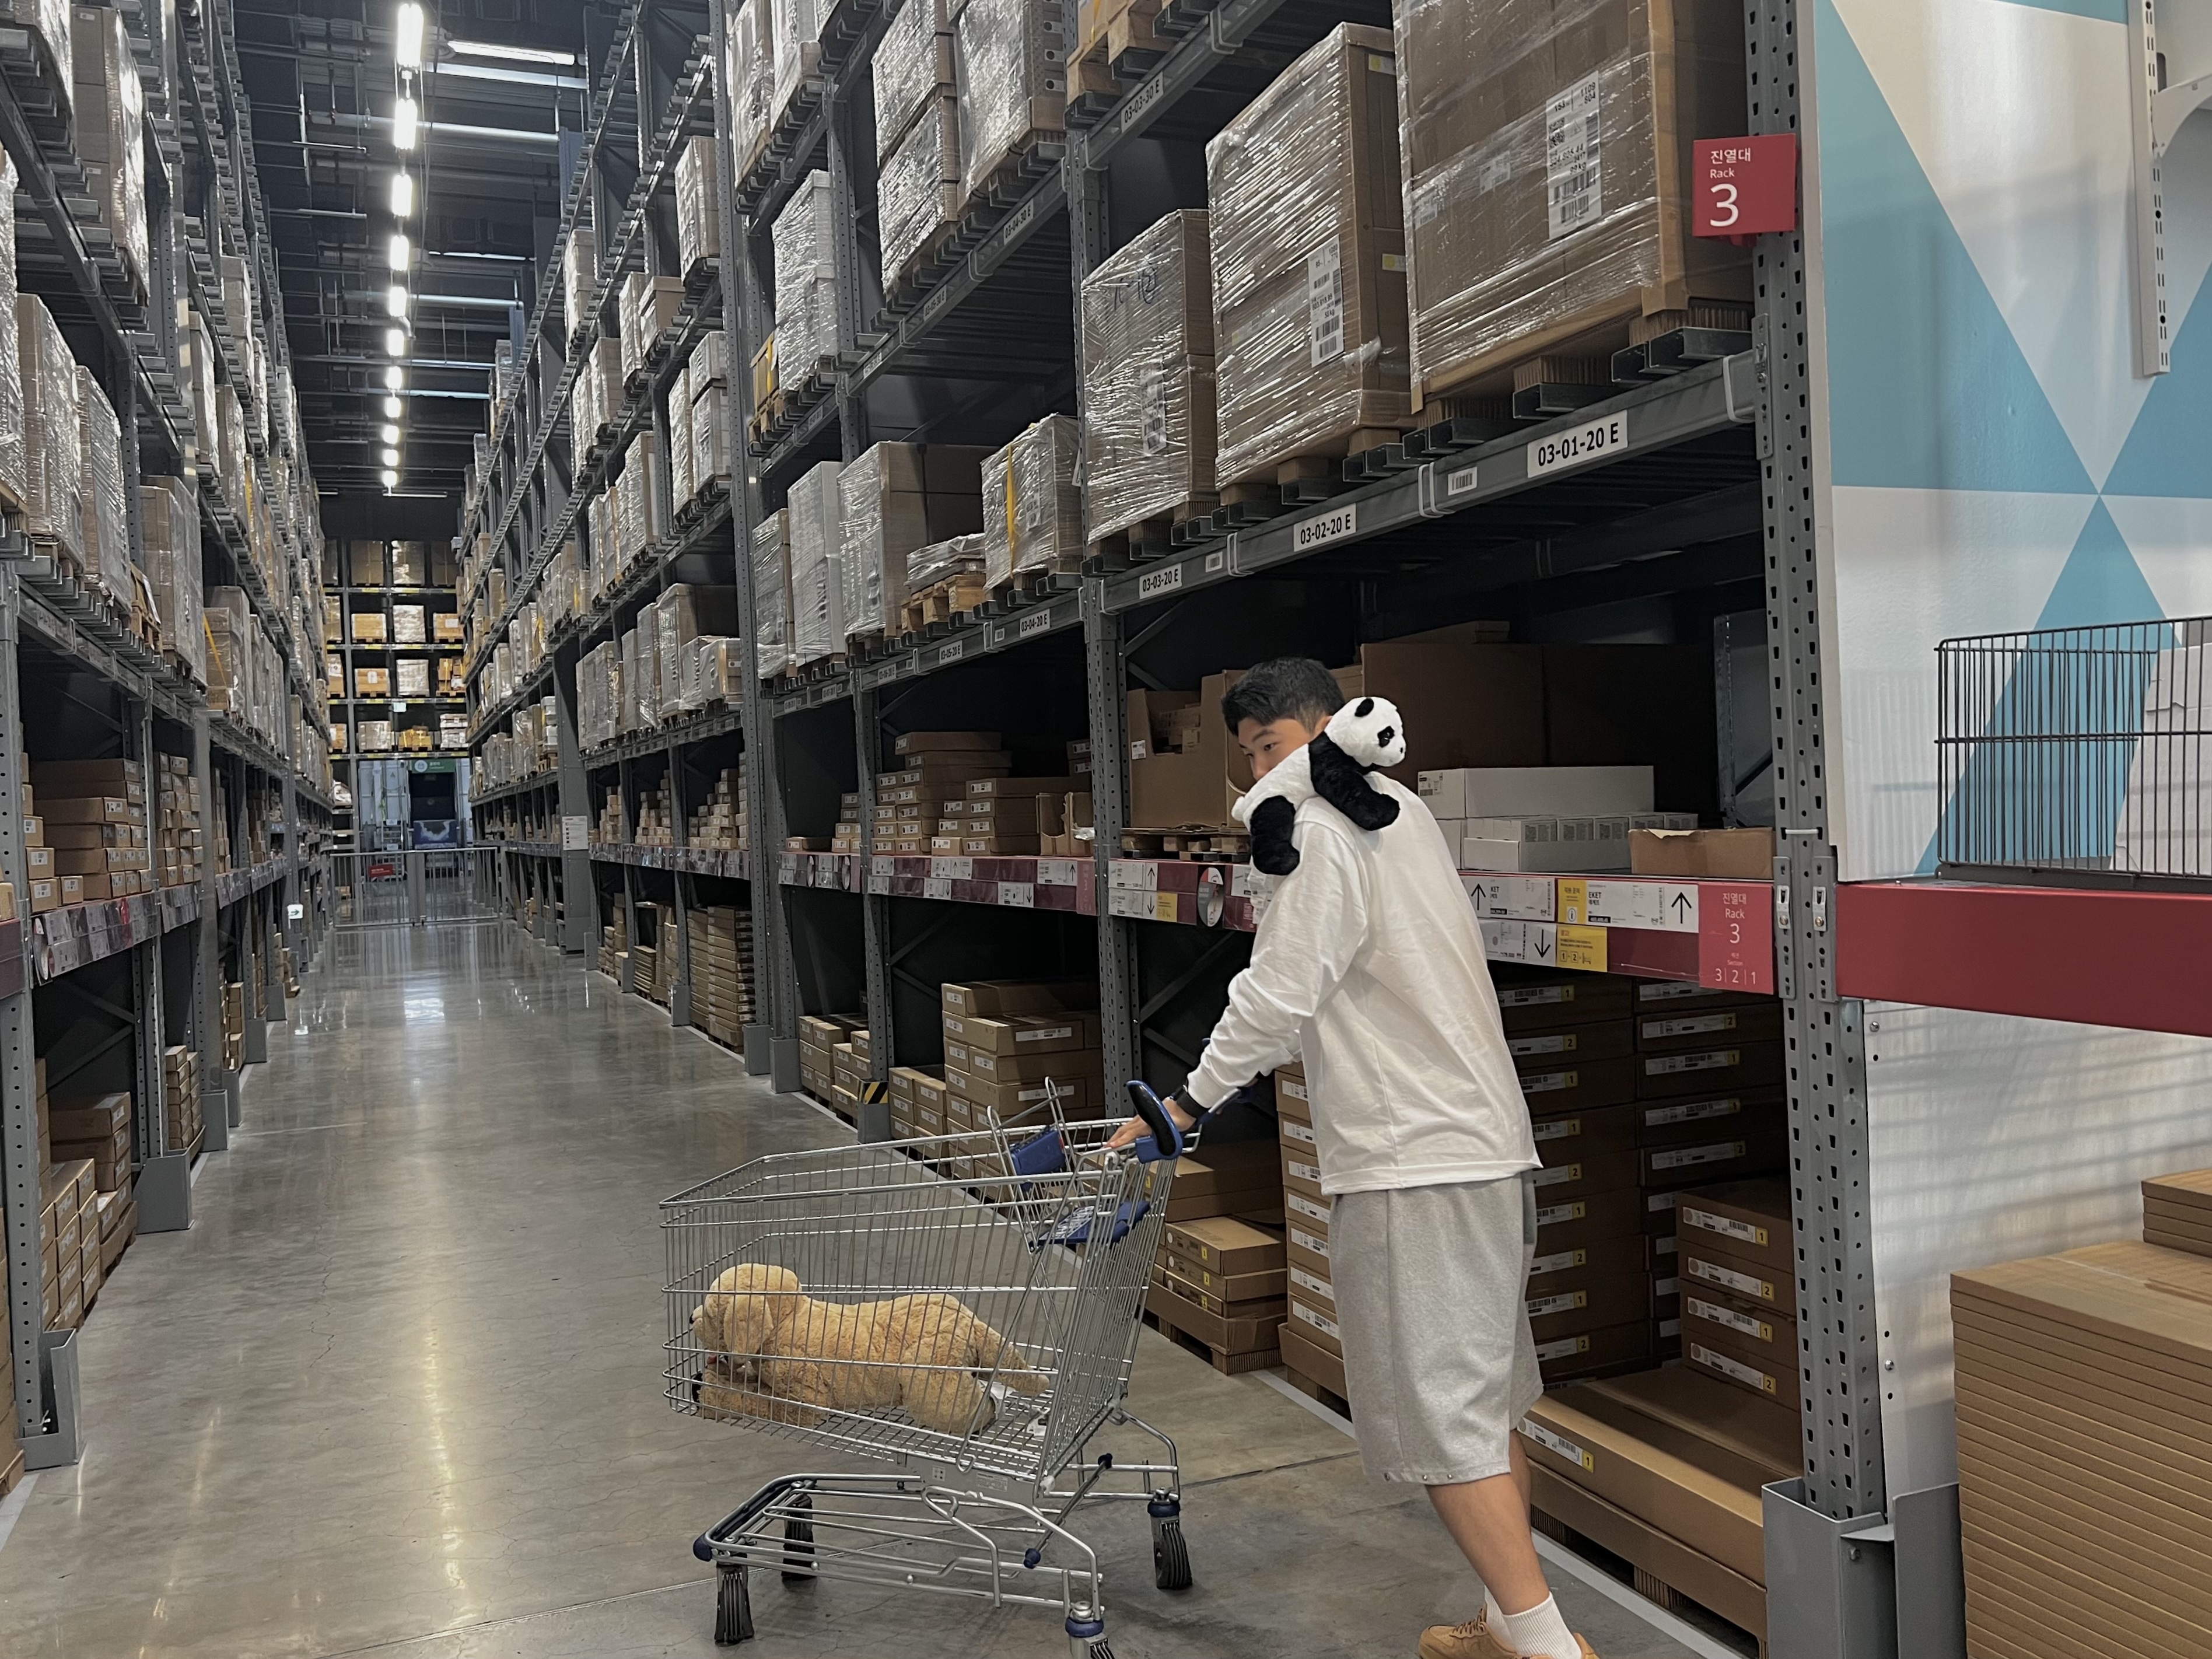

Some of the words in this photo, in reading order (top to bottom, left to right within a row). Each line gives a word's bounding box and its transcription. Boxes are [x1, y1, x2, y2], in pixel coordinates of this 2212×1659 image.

[1124, 85, 1154, 123] 03-03-30
[1156, 79, 1160, 93] E
[1710, 147, 1751, 165] 진열대
[1710, 168, 1735, 179] Rack
[1709, 183, 1740, 228] 3
[1027, 205, 1031, 217] E
[1538, 427, 1604, 467] 03-01-20
[1611, 422, 1619, 444] E
[1300, 516, 1342, 545] 03-02-20
[1345, 513, 1350, 530] E
[1142, 570, 1172, 592] 03-03-20
[1174, 568, 1178, 582] E
[1021, 615, 1043, 632] 03-04-20
[1044, 614, 1047, 624] E
[1723, 892, 1746, 905] 진열대
[1725, 908, 1745, 919] Rack
[1730, 923, 1740, 944] 3
[1715, 968, 1722, 982] 3
[1731, 970, 1739, 984] 2
[1751, 971, 1756, 985] 1
[1728, 1017, 1732, 1026] 2
[1567, 1038, 1573, 1047] 2
[1732, 1054, 1735, 1062] 1
[1570, 1075, 1573, 1083] 1
[1572, 1124, 1576, 1132] 1
[1737, 1144, 1742, 1153] 2
[1573, 1168, 1578, 1177] 2
[1576, 1206, 1580, 1215] 1
[1760, 1233, 1763, 1241] 1
[1577, 1254, 1583, 1262] 2
[1765, 1286, 1770, 1295] 2
[1578, 1296, 1582, 1304] 1
[1764, 1328, 1768, 1337] 1
[1581, 1340, 1586, 1349] 2
[1766, 1380, 1772, 1390] 2
[1586, 1457, 1590, 1466] 1
